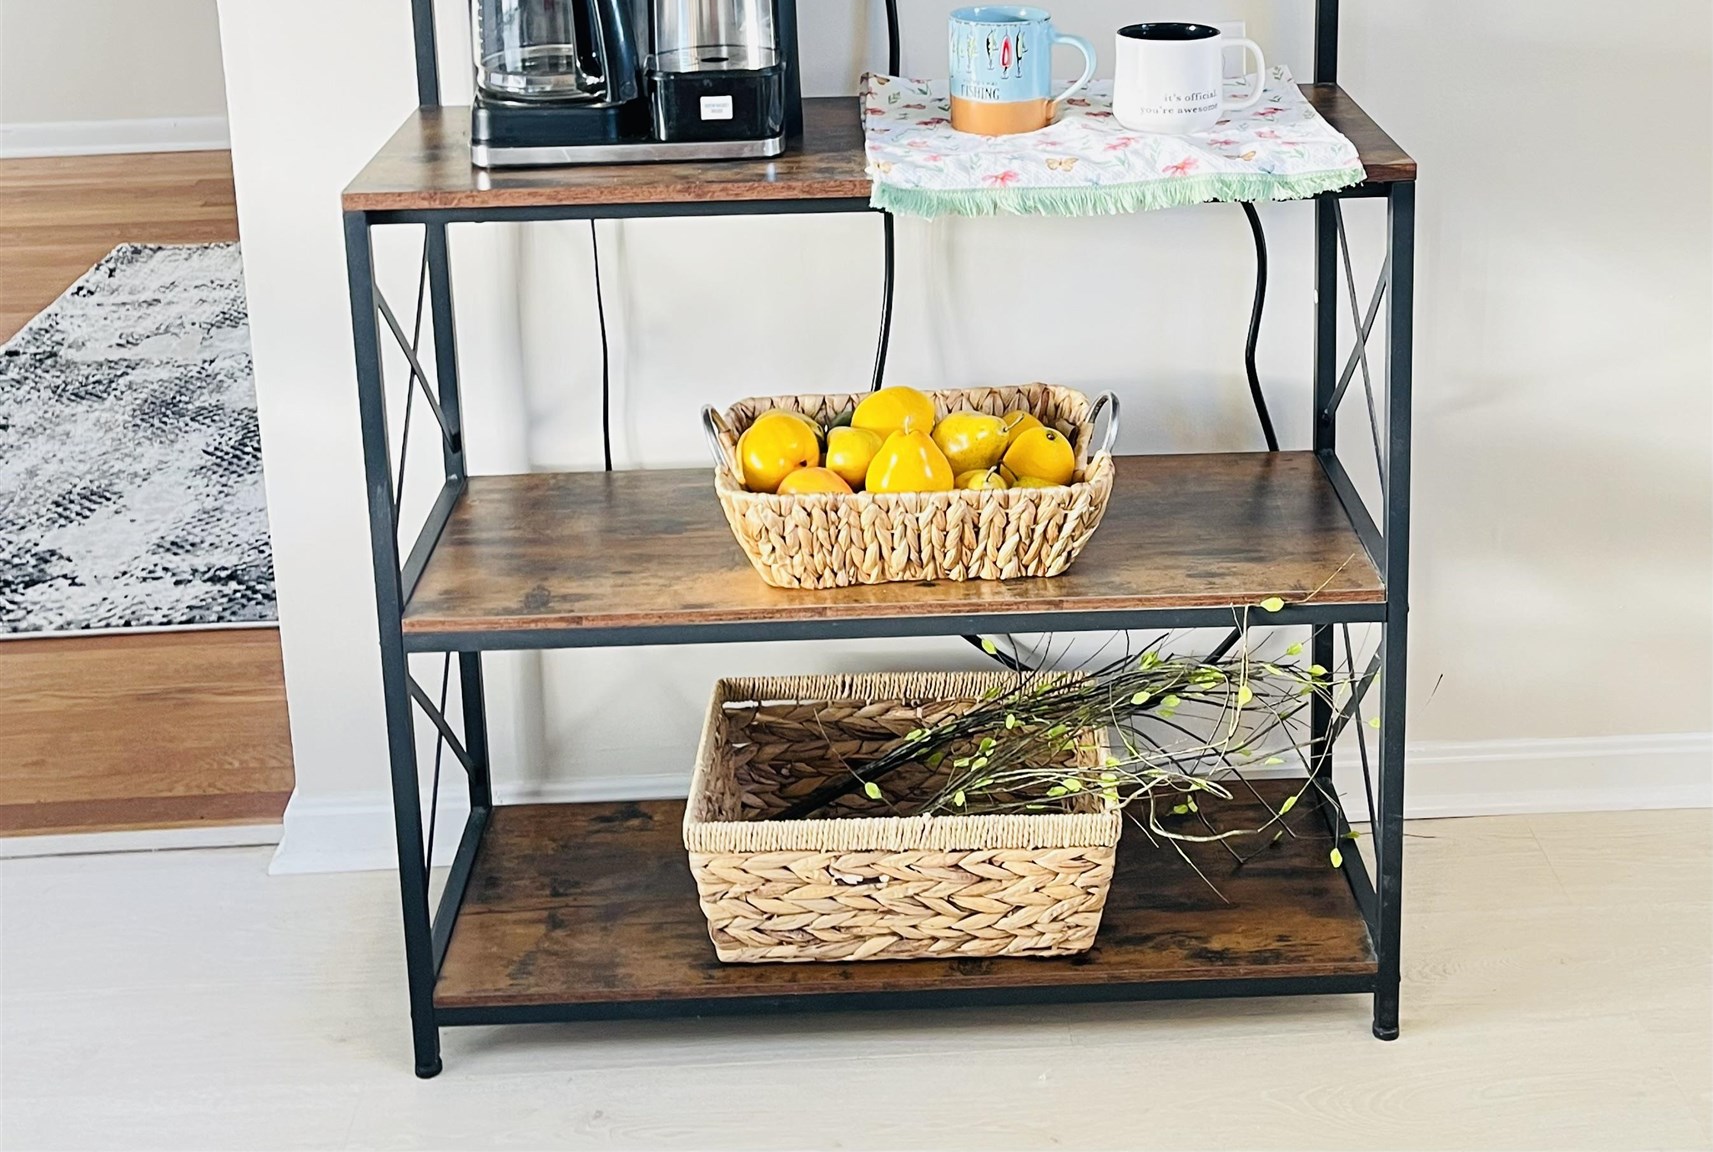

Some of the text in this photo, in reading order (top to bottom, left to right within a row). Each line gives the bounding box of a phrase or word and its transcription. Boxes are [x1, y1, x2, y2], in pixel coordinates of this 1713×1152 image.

[961, 83, 1000, 100] FISHING
[1164, 92, 1182, 102] it's
[1139, 102, 1218, 115] you're awesome
